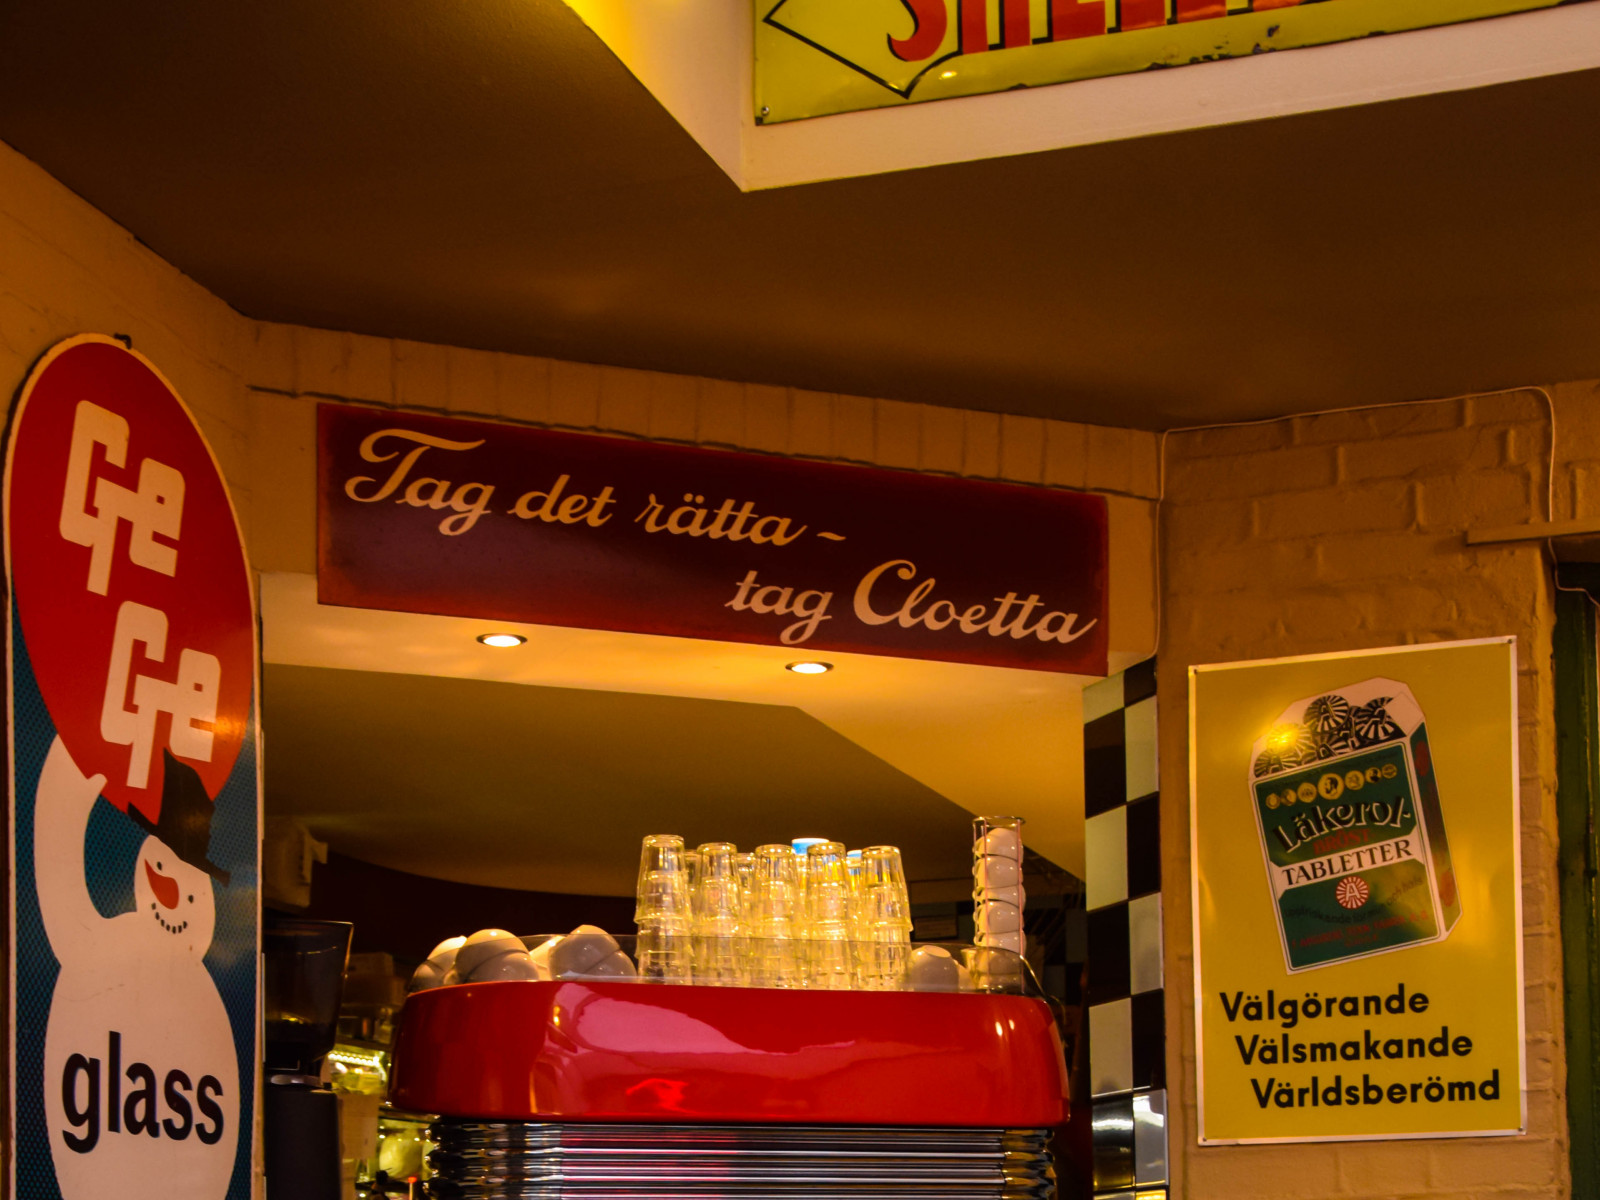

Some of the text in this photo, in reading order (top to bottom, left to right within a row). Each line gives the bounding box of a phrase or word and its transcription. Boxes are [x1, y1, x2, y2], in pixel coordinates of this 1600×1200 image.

[344, 428, 496, 537] Tag
[506, 473, 617, 528] det
[634, 493, 808, 547] rätta
[723, 558, 1098, 645] tag Cloetta
[1281, 839, 1413, 886] TABLETTER
[1219, 982, 1430, 1029] Välgörande
[1234, 1026, 1473, 1065] Välsmakande
[61, 1030, 225, 1154] glass
[1250, 1069, 1501, 1109] Världsberömd
